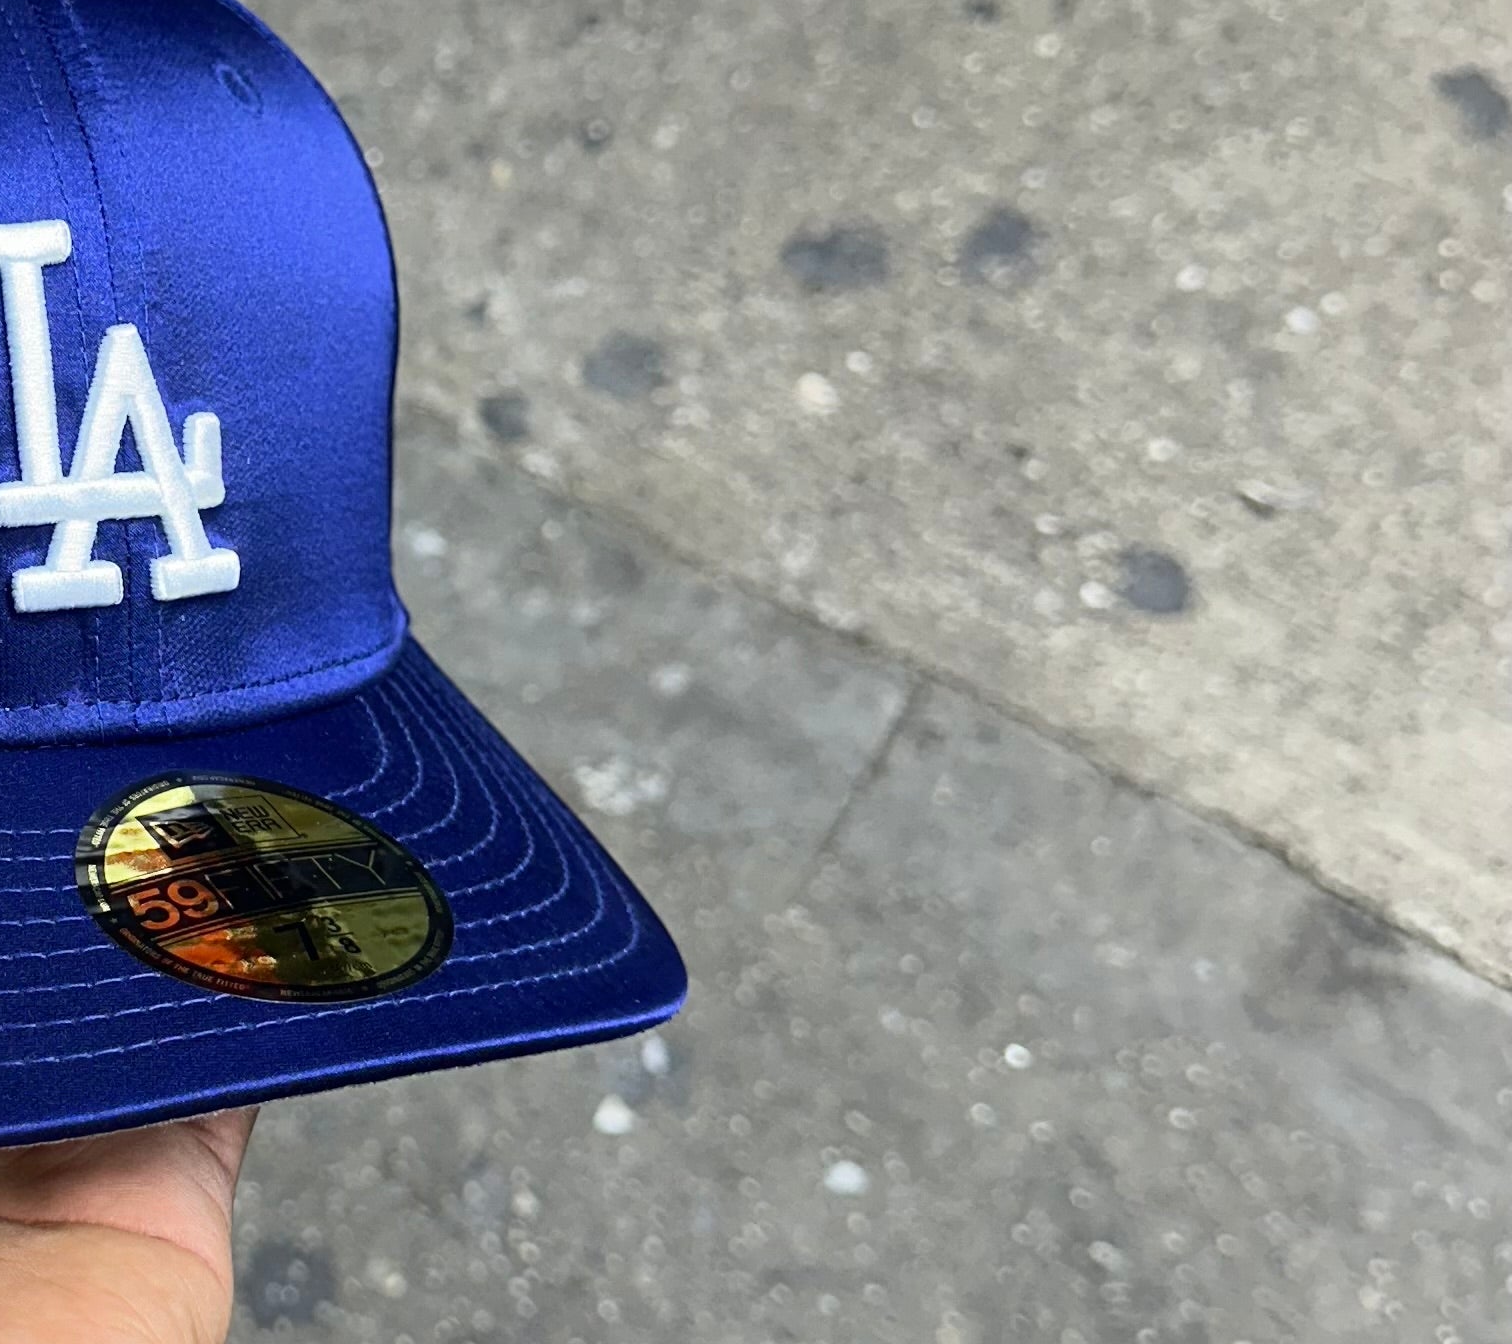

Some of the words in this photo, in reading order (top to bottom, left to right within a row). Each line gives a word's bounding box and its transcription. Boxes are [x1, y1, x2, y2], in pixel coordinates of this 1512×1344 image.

[219, 804, 270, 822] NEW
[230, 817, 283, 834] ERA
[272, 921, 320, 961] 7
